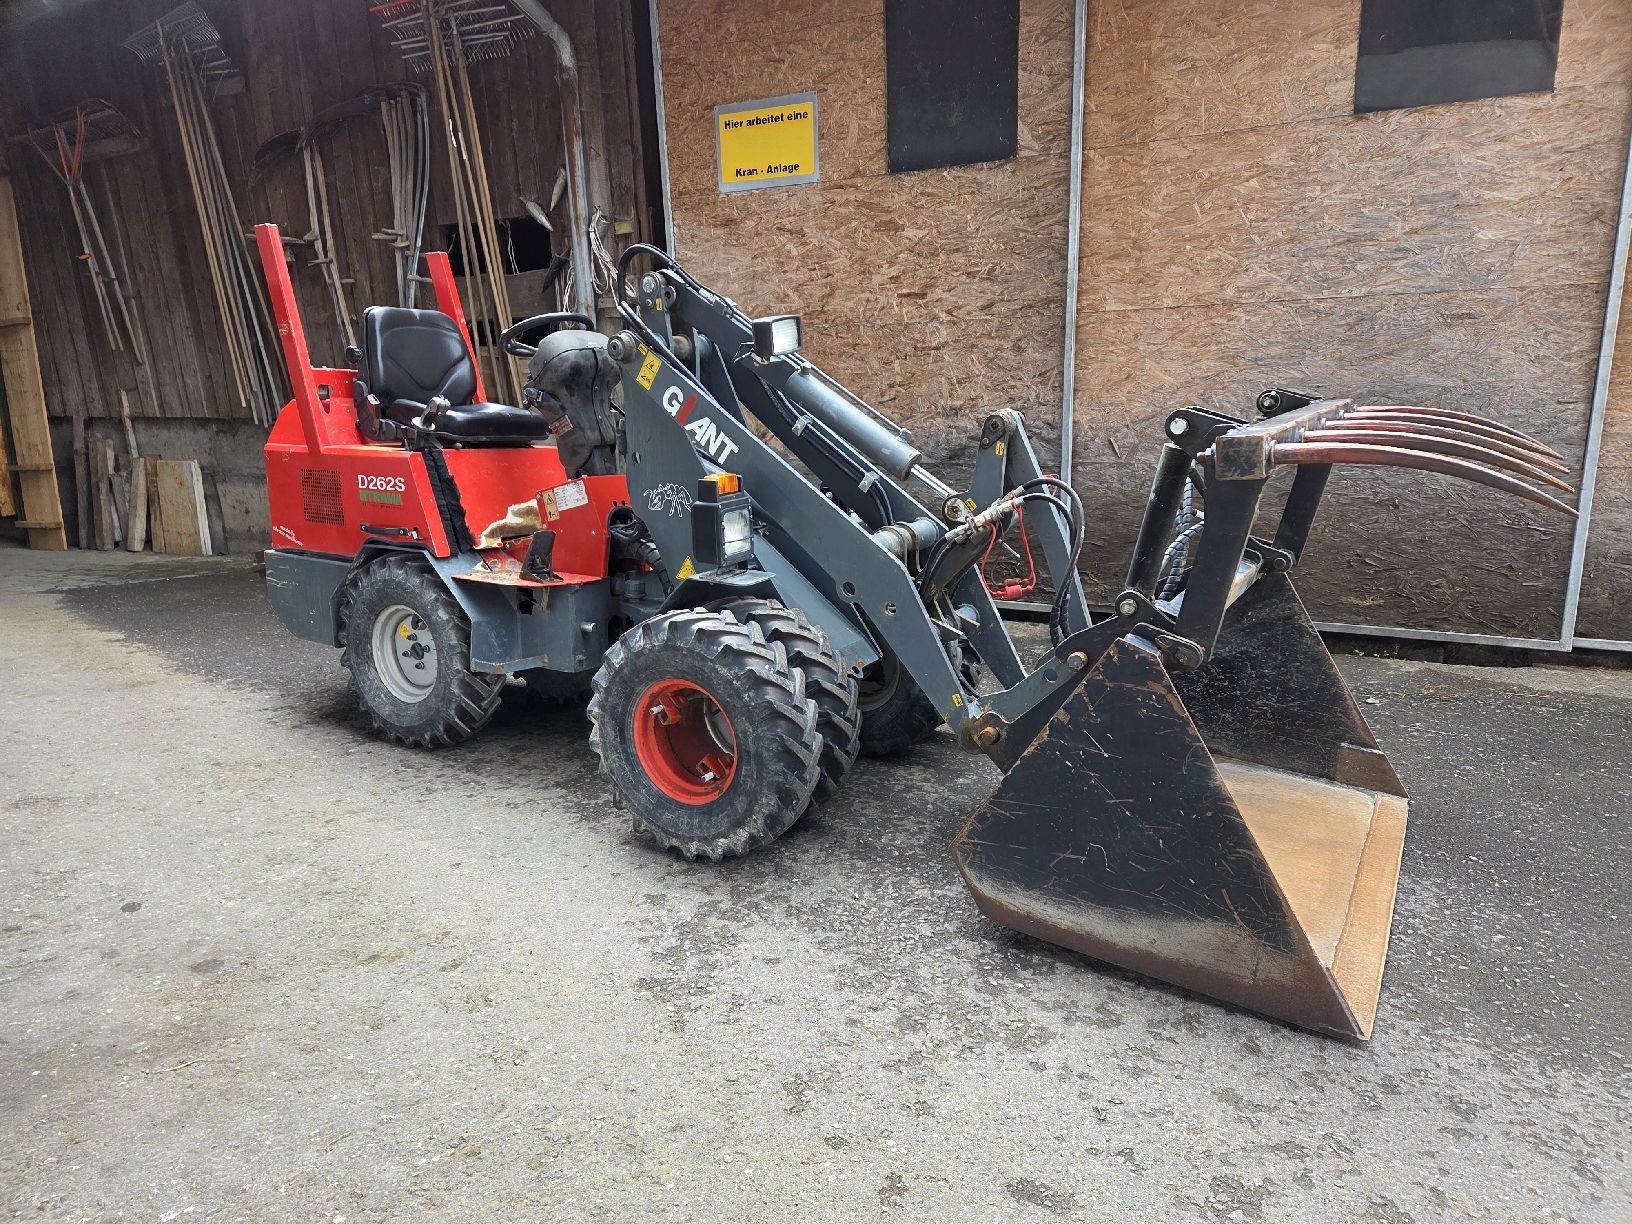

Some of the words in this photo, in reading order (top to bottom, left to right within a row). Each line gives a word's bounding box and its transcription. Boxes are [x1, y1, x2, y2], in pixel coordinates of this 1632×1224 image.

[724, 120, 743, 129] Hier
[746, 113, 784, 126] arbeitet
[787, 110, 808, 120] eine
[735, 168, 758, 177] Kran
[767, 163, 800, 173] Anlage
[662, 385, 740, 465] GIANT
[357, 474, 406, 492] D262S
